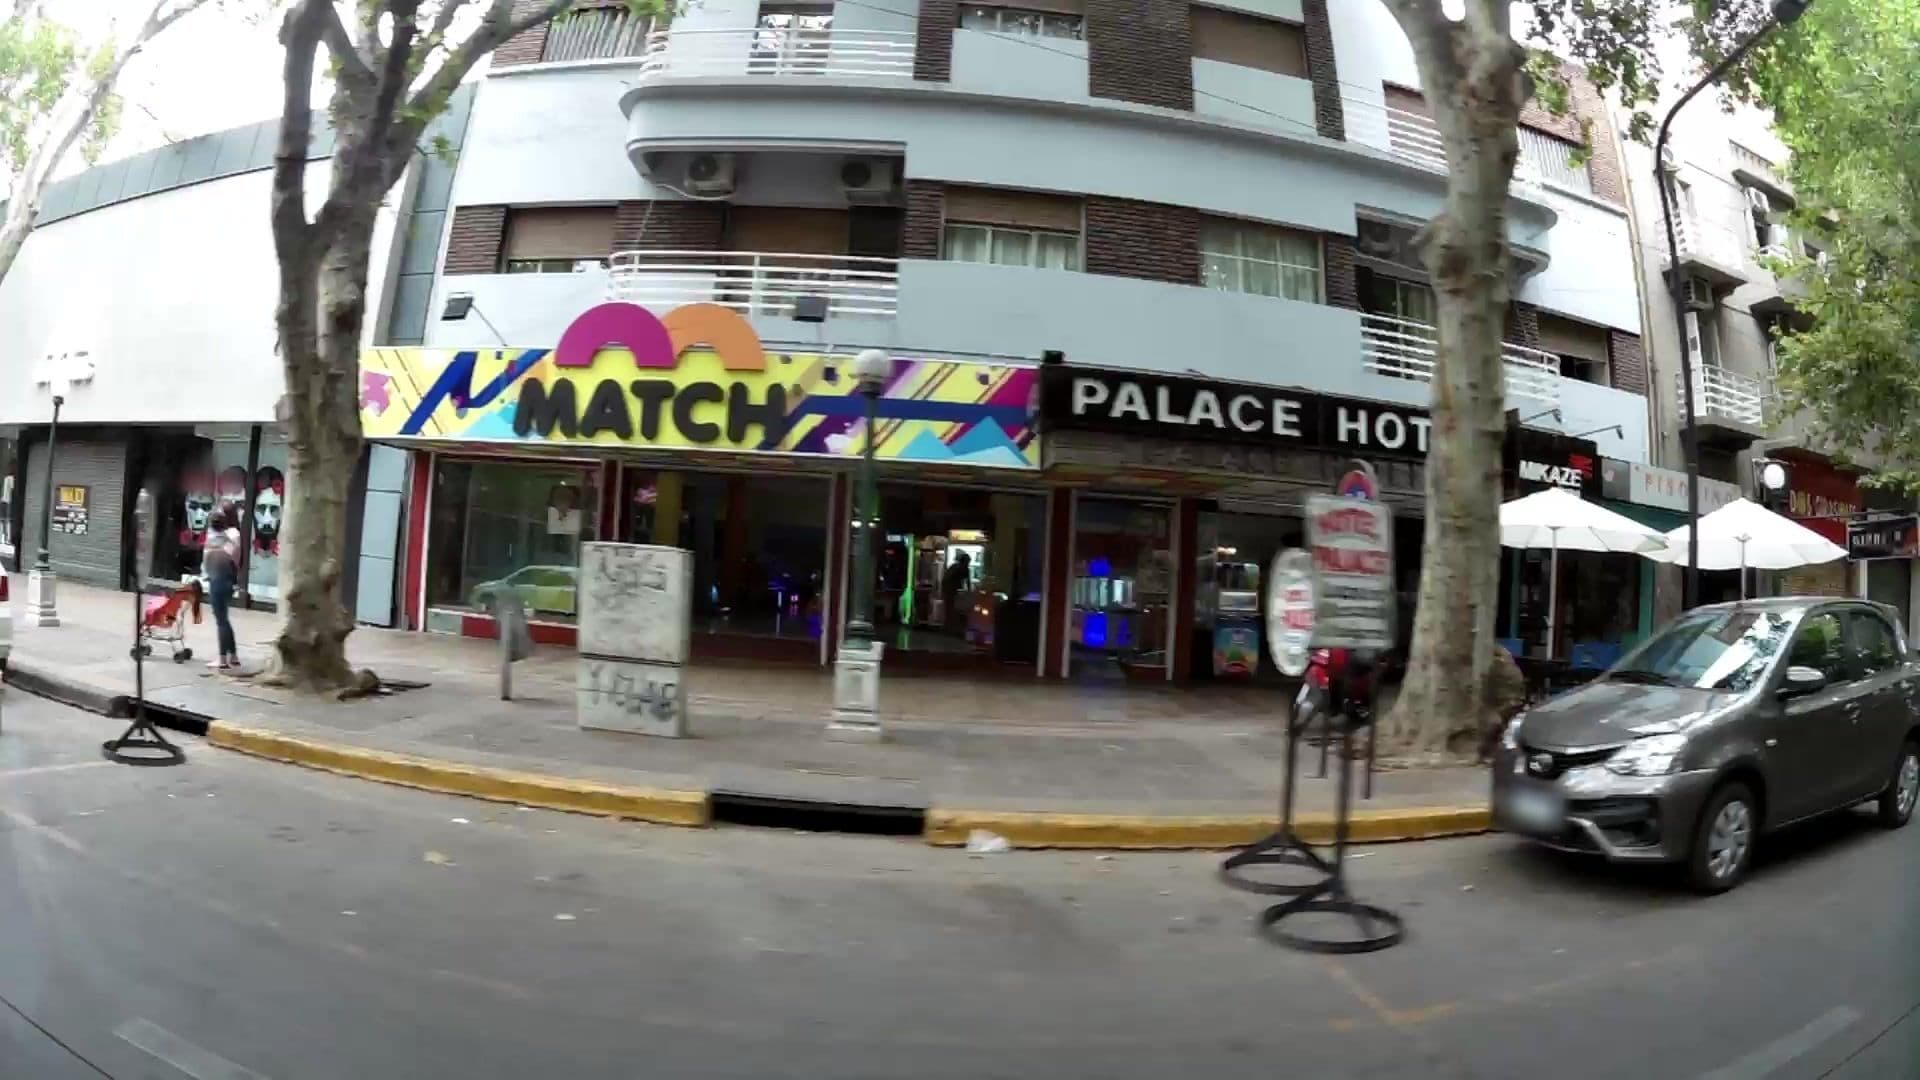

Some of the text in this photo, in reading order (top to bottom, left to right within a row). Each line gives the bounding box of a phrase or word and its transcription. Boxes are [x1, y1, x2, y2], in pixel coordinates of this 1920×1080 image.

[513, 377, 788, 443] MATCH
[1071, 377, 1432, 453] PALACE HOT
